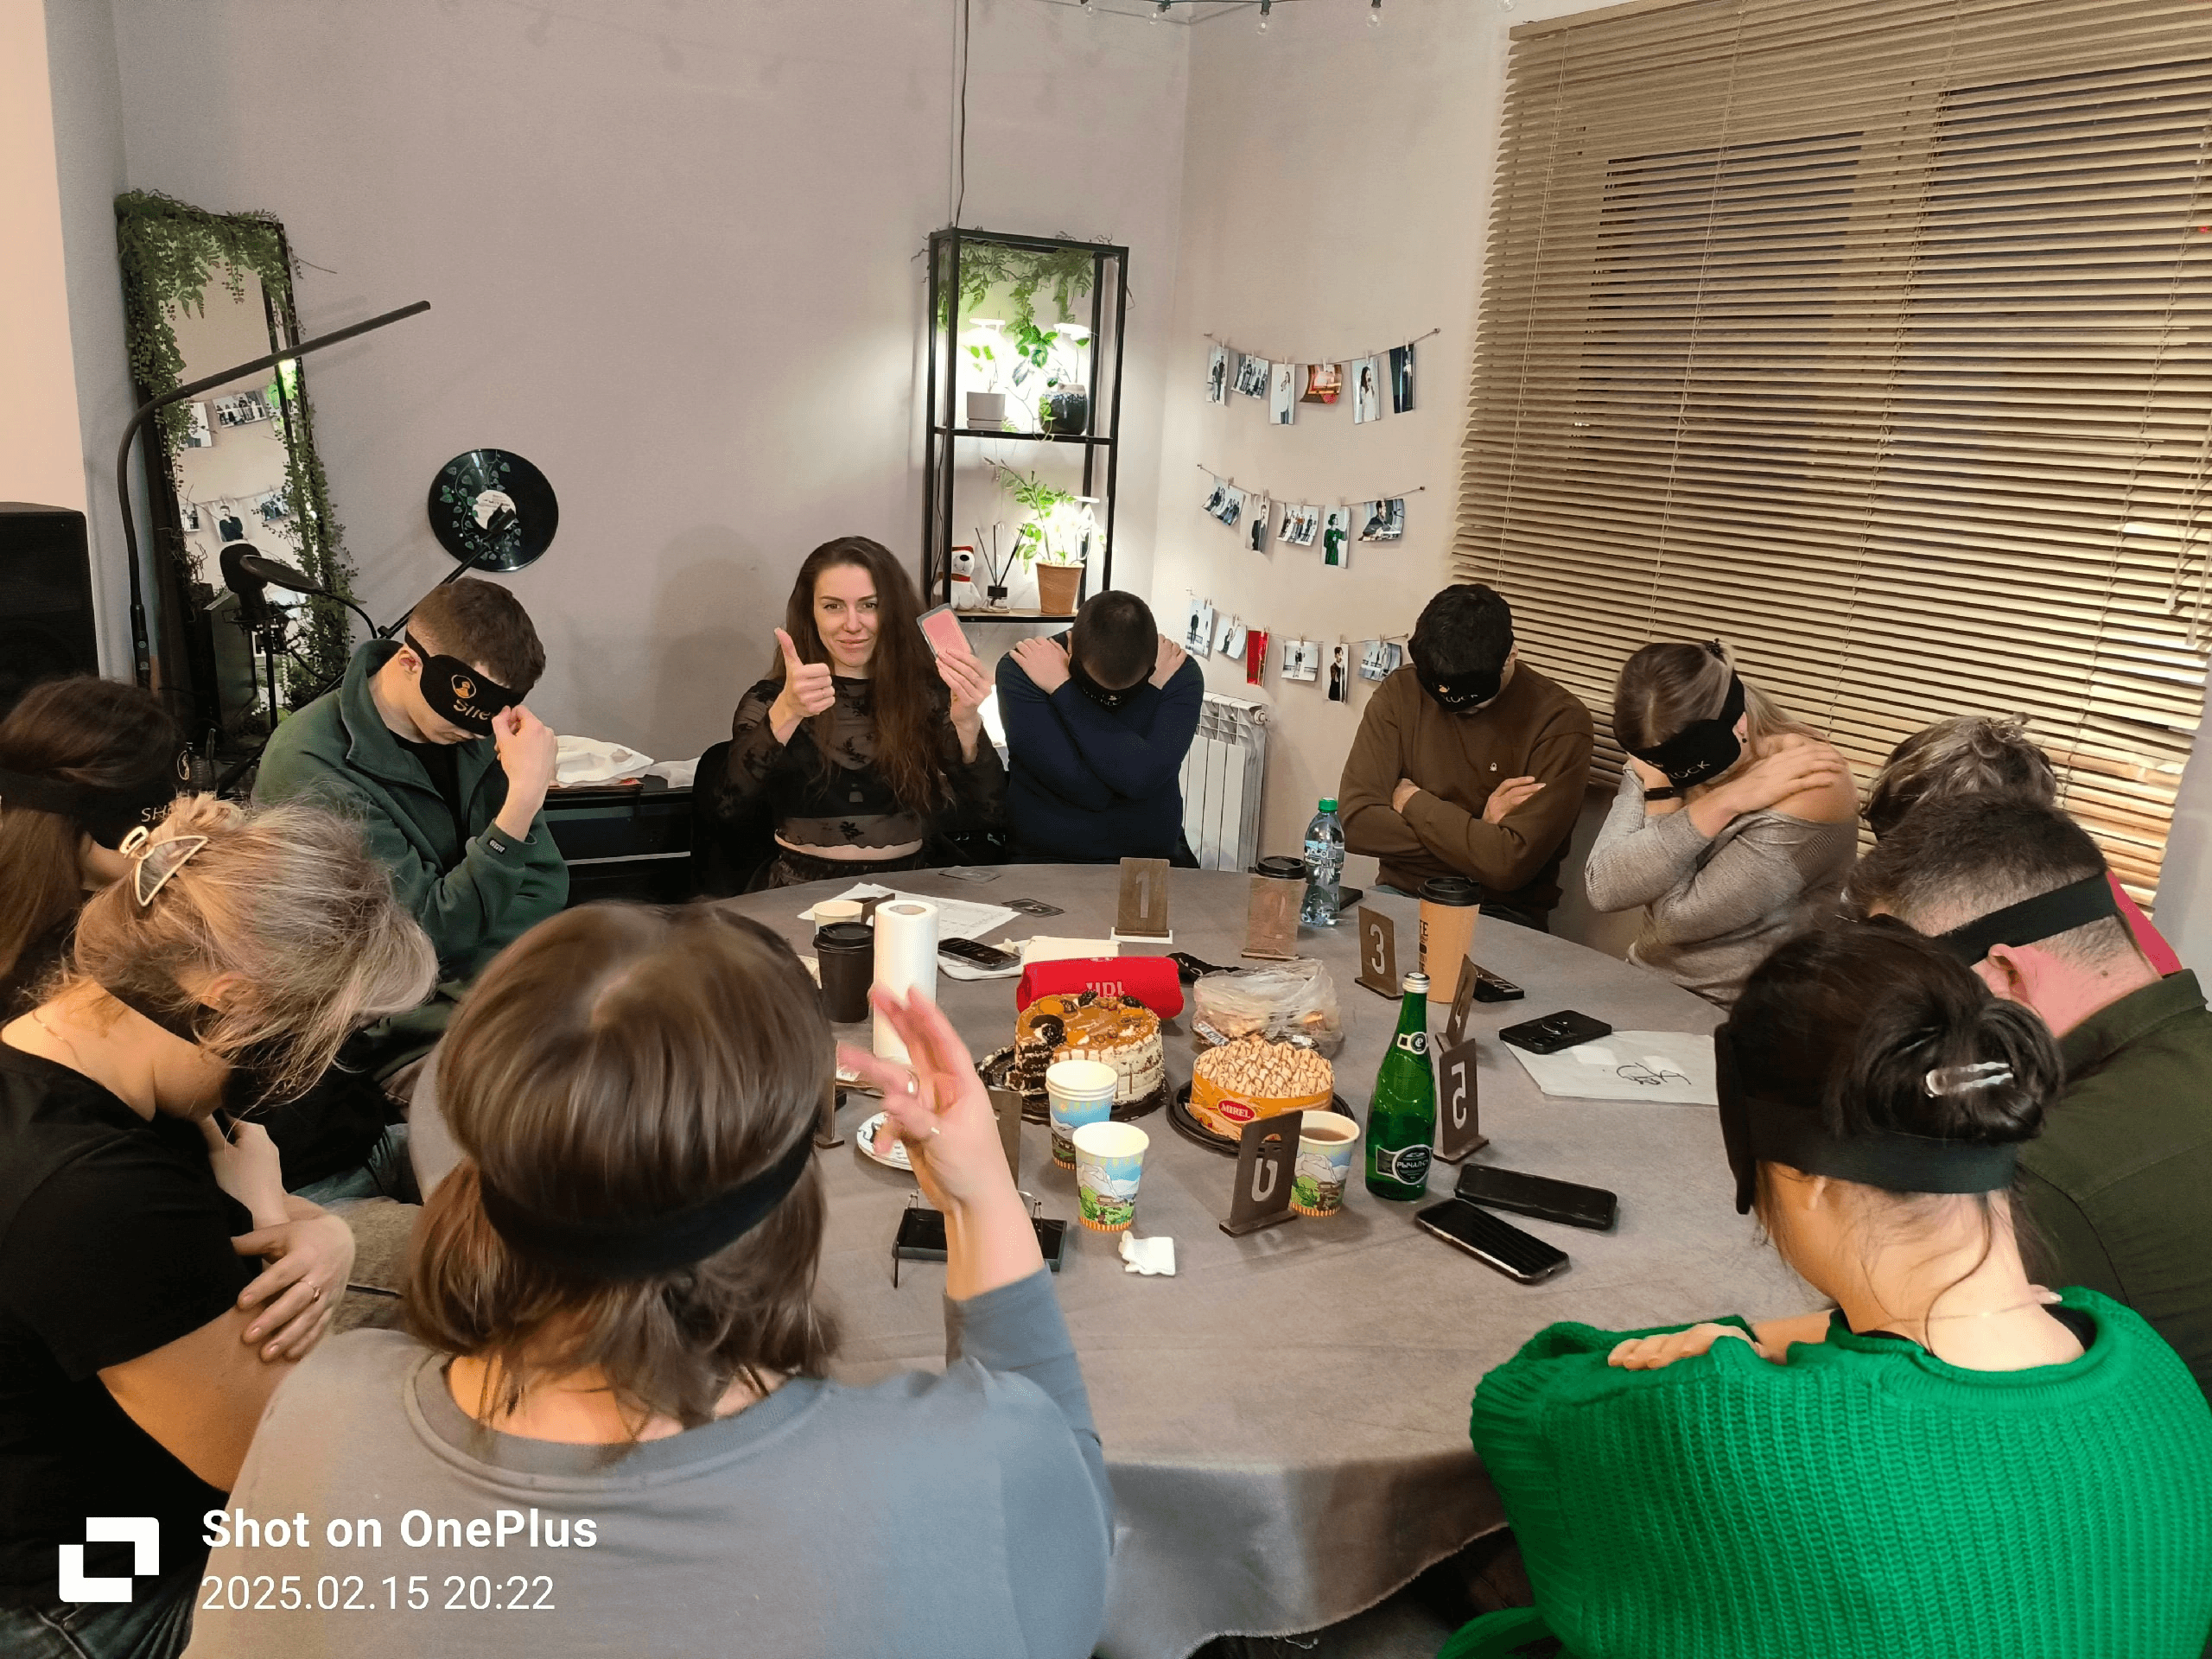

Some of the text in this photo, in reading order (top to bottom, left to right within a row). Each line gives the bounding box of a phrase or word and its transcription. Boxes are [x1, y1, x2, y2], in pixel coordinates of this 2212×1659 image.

[1135, 870, 1149, 918] 1
[1369, 924, 1386, 975] 3
[1220, 1103, 1251, 1119] MIREL
[1251, 1133, 1283, 1203] 6
